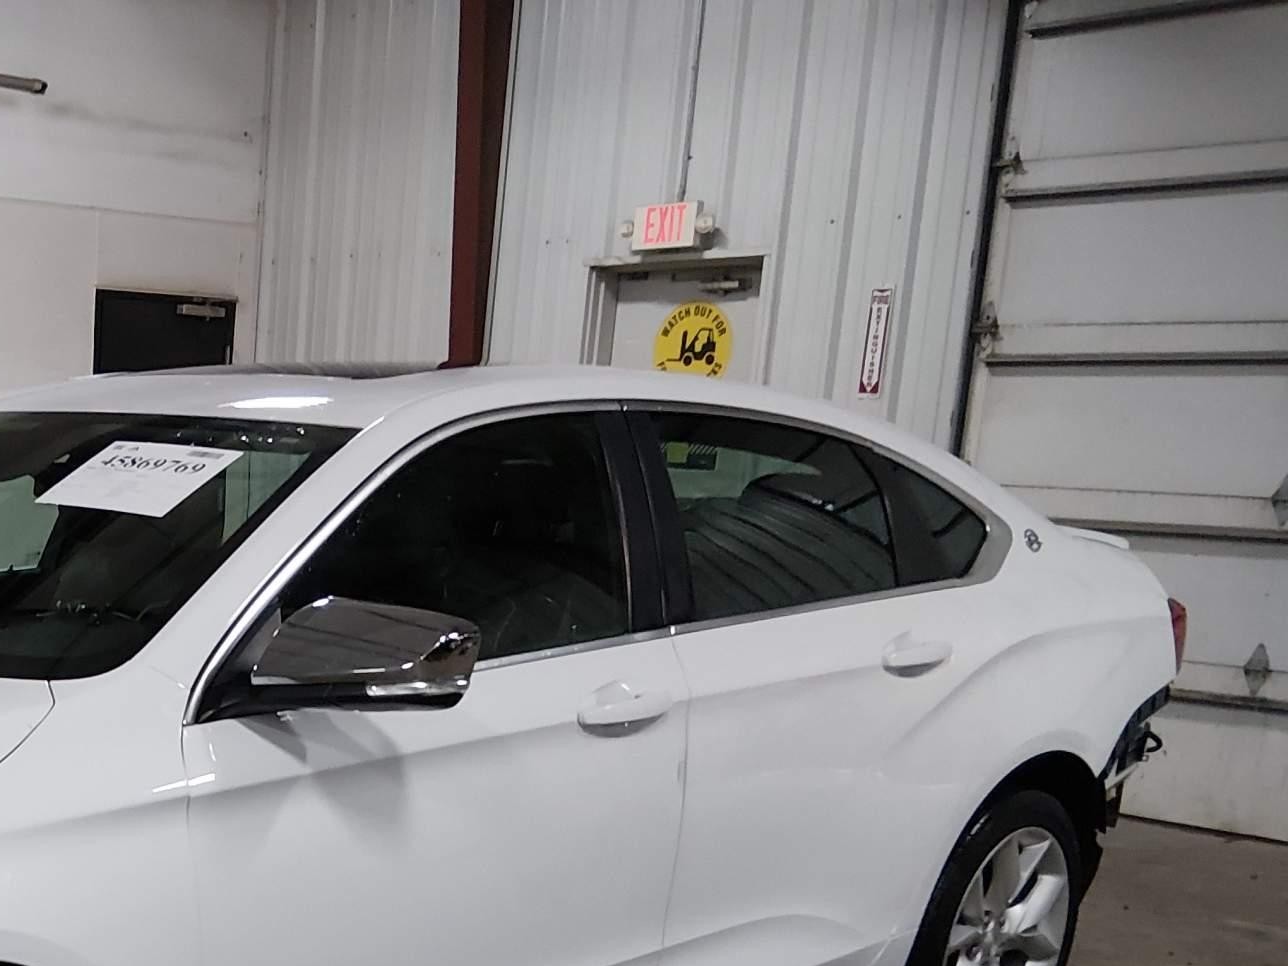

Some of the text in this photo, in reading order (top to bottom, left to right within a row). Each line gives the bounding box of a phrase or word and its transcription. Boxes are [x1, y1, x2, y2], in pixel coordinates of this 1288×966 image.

[644, 204, 688, 243] EXIT
[661, 304, 727, 338] WATCH OUT FOR
[101, 454, 206, 474] 45869769
